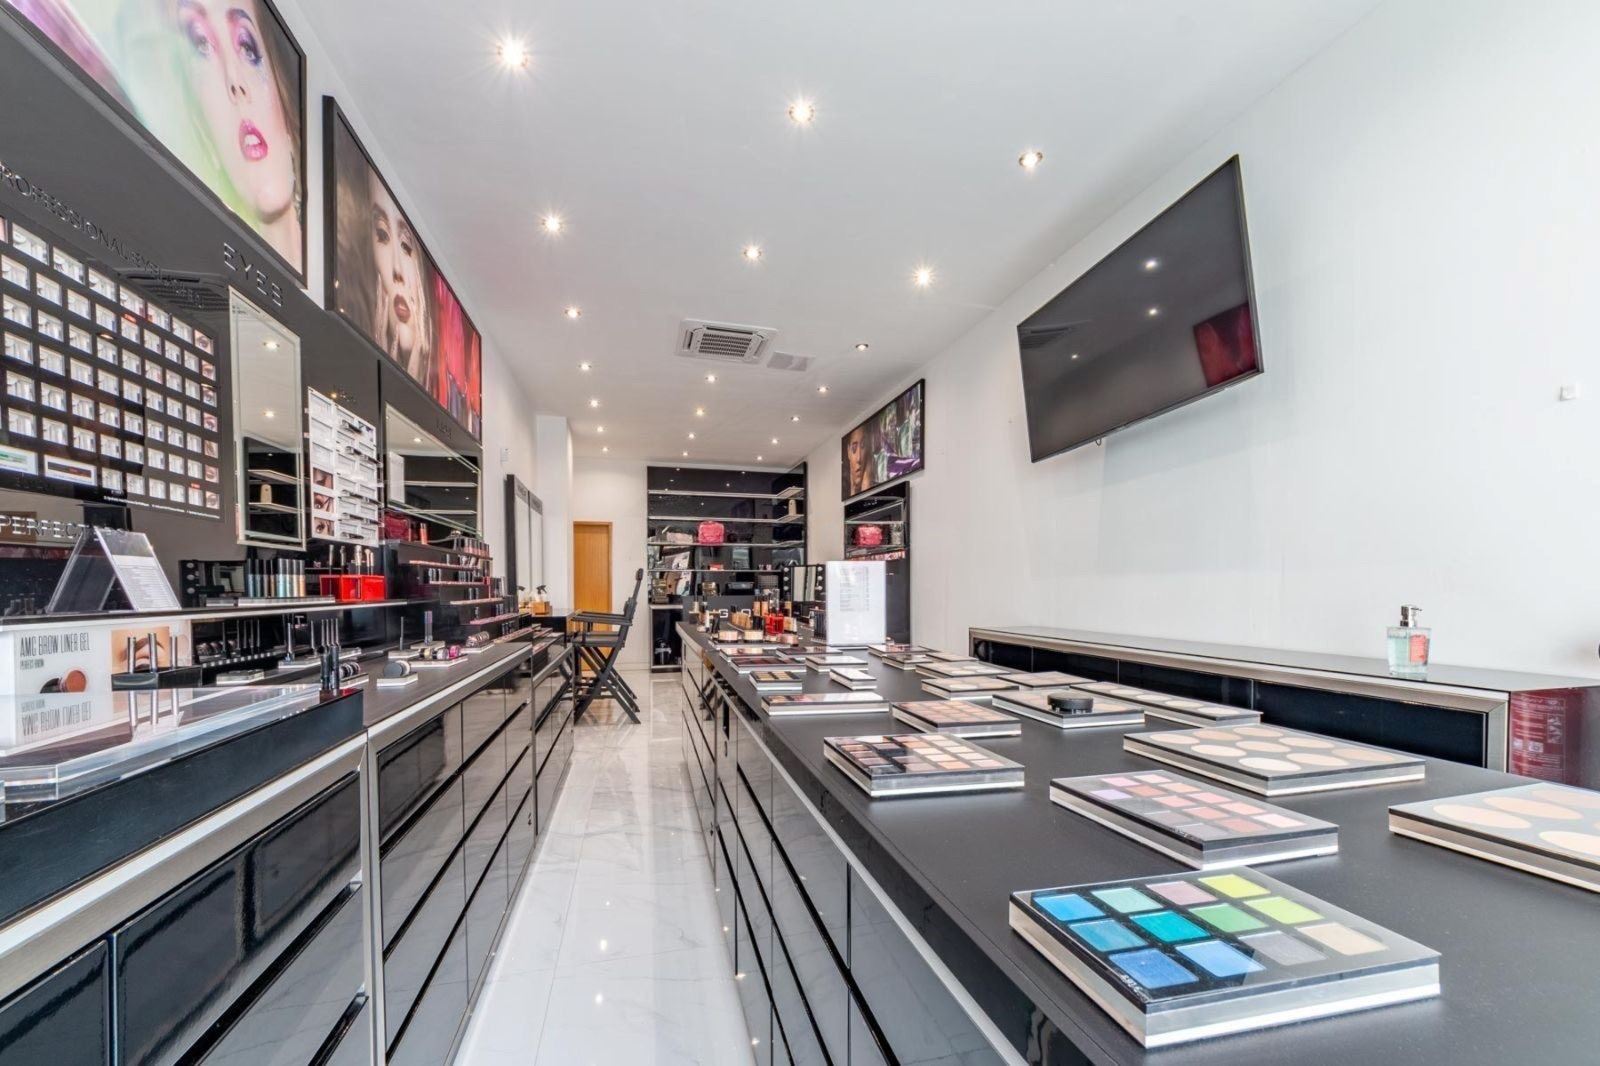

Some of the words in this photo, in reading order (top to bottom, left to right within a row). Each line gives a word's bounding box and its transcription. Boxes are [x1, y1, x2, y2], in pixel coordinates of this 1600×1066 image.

[0, 161, 128, 262] ROFESSIONAL
[224, 243, 282, 307] EYES
[38, 634, 59, 656] BROW
[60, 633, 79, 653] LINER
[79, 632, 90, 651] GEL
